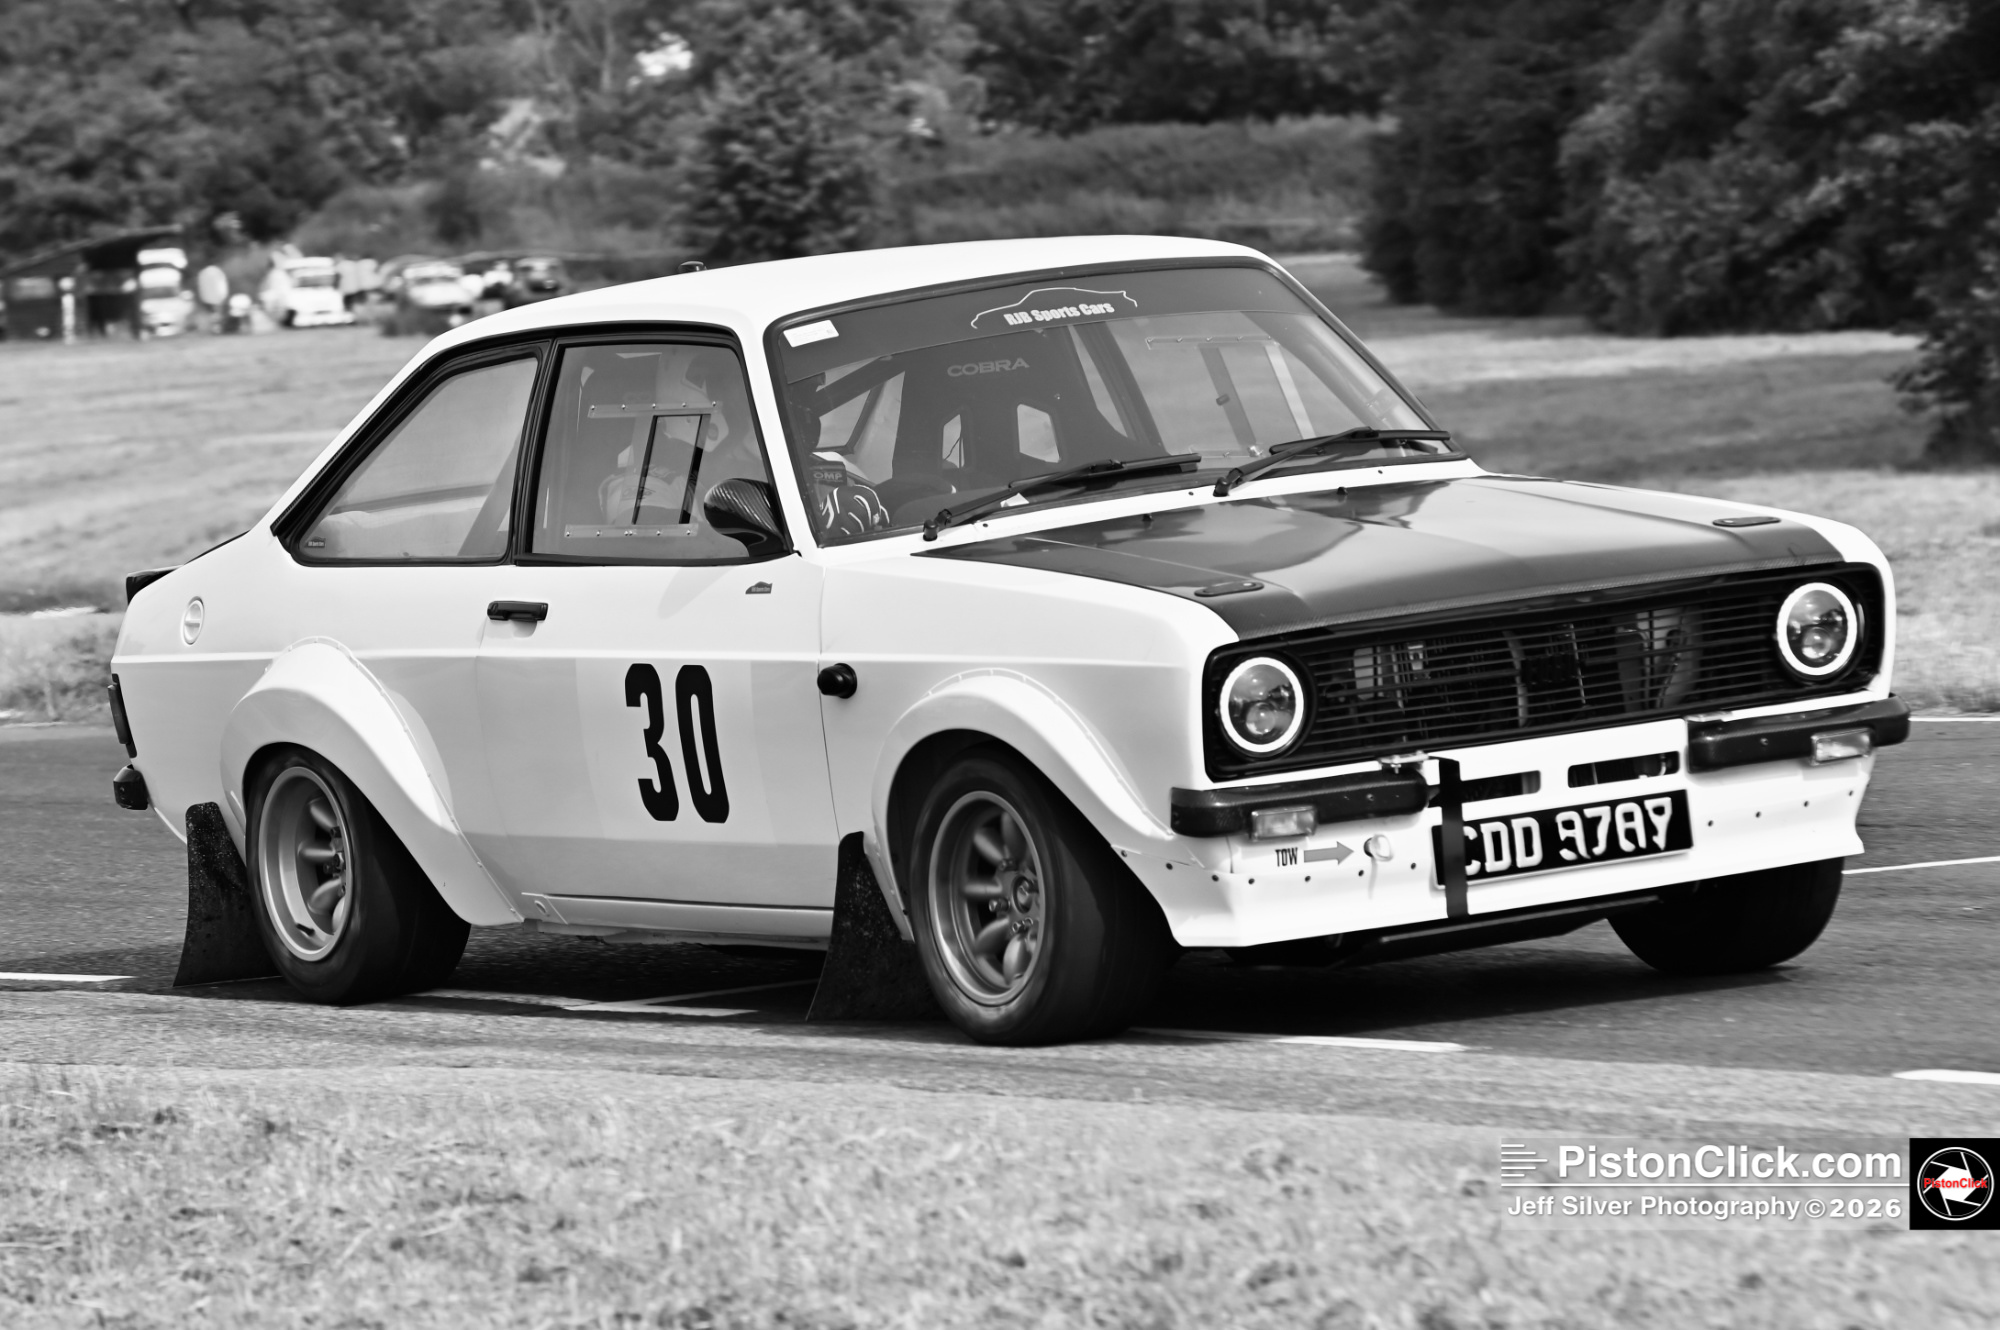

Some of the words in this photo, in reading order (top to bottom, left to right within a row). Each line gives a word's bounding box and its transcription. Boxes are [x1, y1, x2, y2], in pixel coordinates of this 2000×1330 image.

[1003, 311, 1033, 326] RJB
[1030, 306, 1081, 321] Sports
[1079, 303, 1115, 315] Cars
[947, 357, 1030, 377] COBRA
[813, 472, 843, 480] OMP
[625, 663, 730, 824] 30
[1275, 847, 1298, 867] TOW
